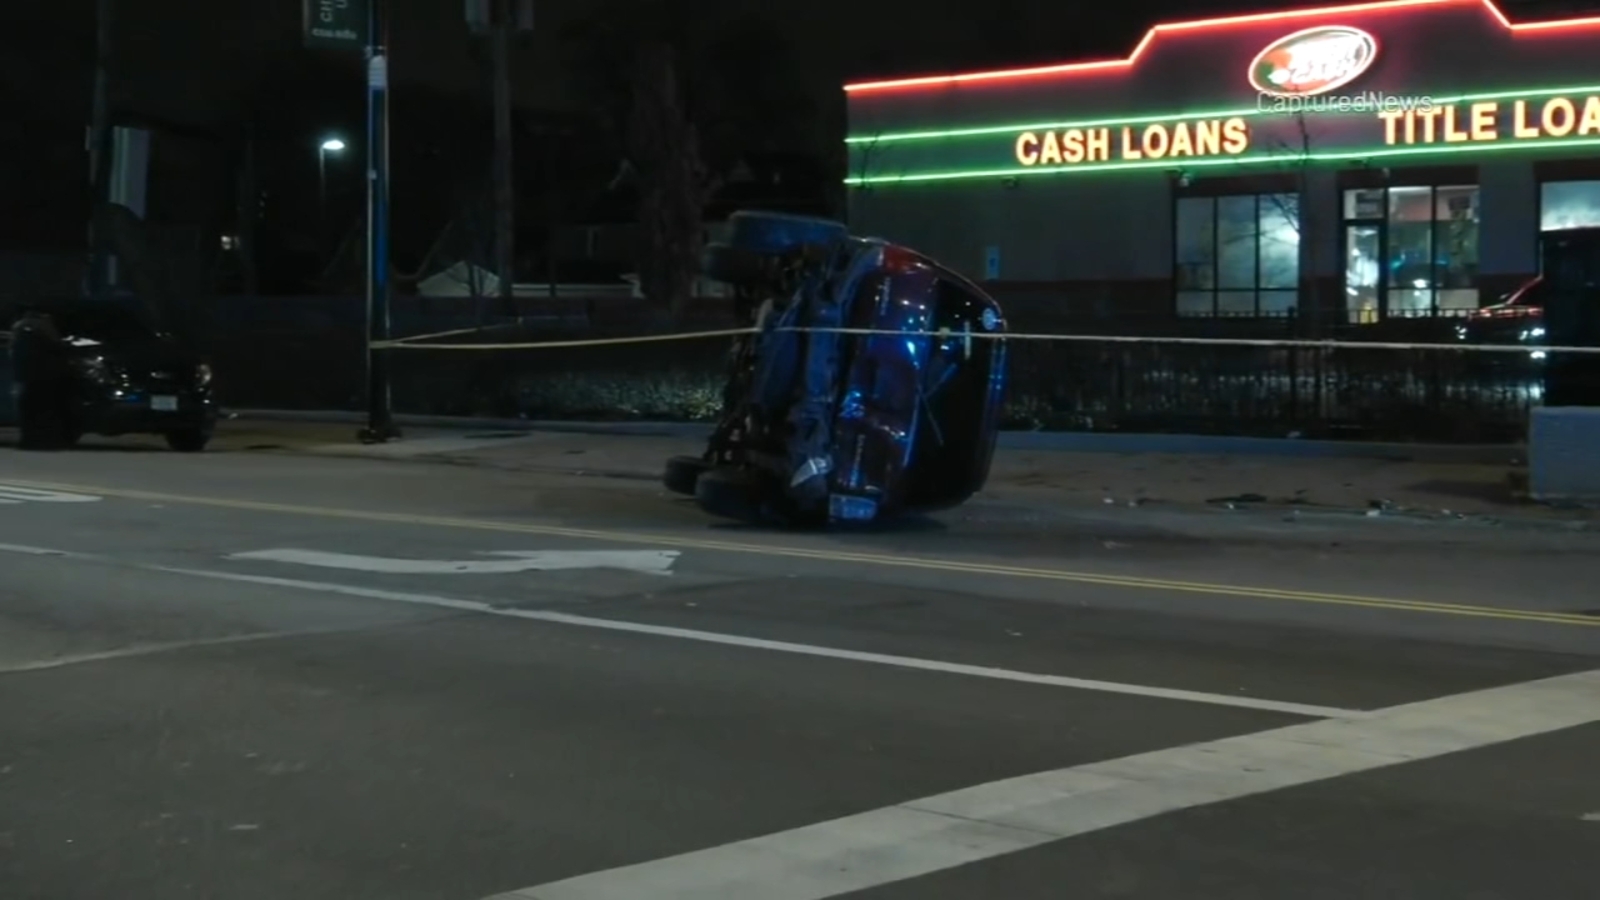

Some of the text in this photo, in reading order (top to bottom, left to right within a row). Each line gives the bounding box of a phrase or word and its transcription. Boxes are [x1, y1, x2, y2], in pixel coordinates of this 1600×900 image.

[1016, 118, 1248, 166] CASH LOANS
[1378, 102, 1498, 145] TITLE
